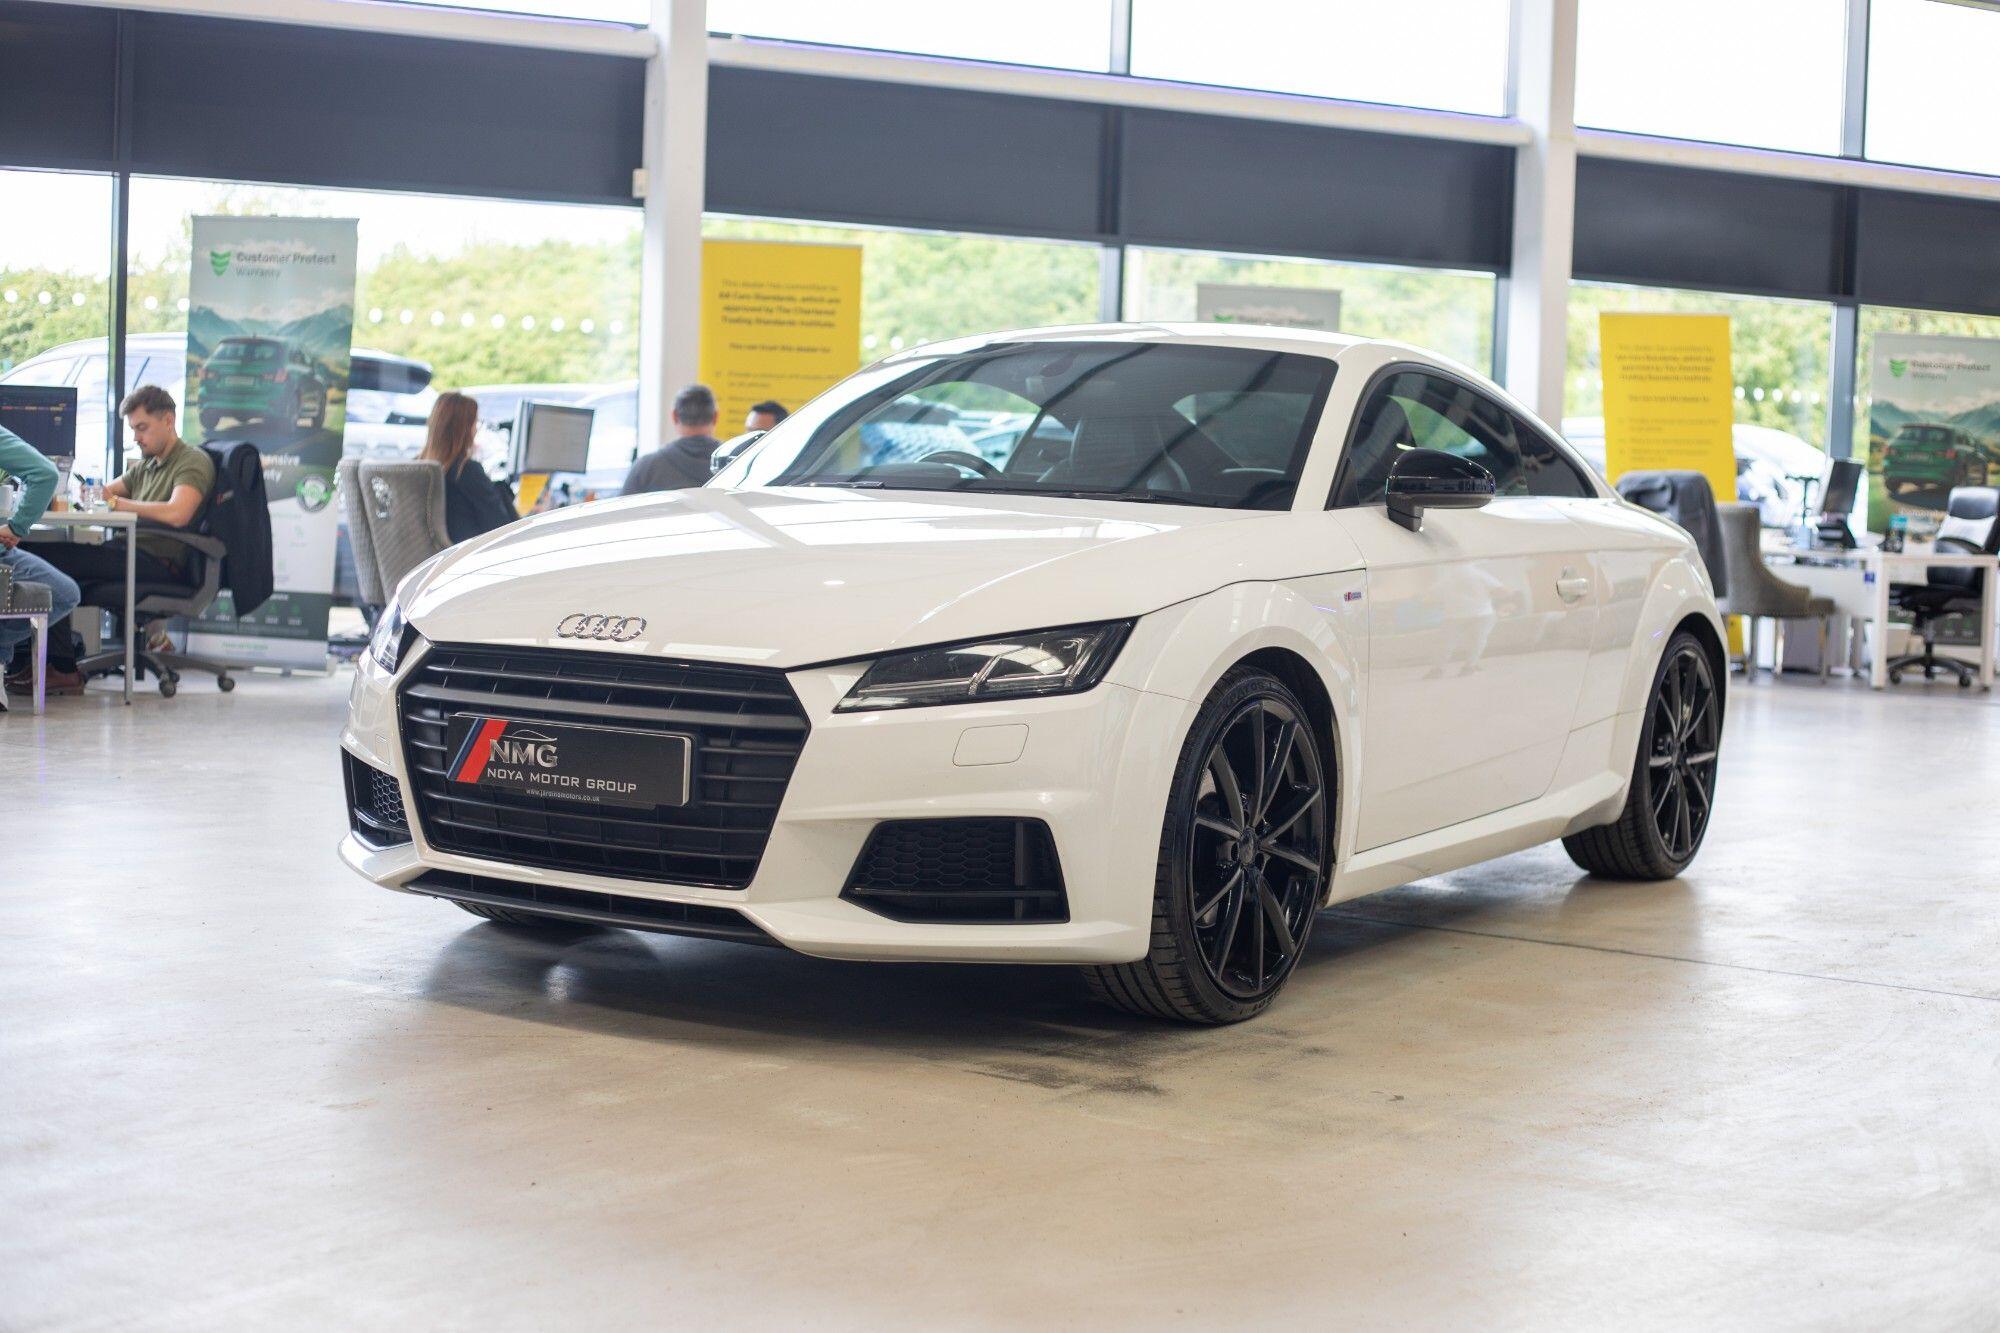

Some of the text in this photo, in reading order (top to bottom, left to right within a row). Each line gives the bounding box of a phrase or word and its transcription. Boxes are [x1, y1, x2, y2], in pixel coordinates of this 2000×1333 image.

[236, 251, 336, 264] Customer Protect
[489, 738, 558, 769] NMG
[487, 767, 637, 794] NOYA MOTOR GROUP
